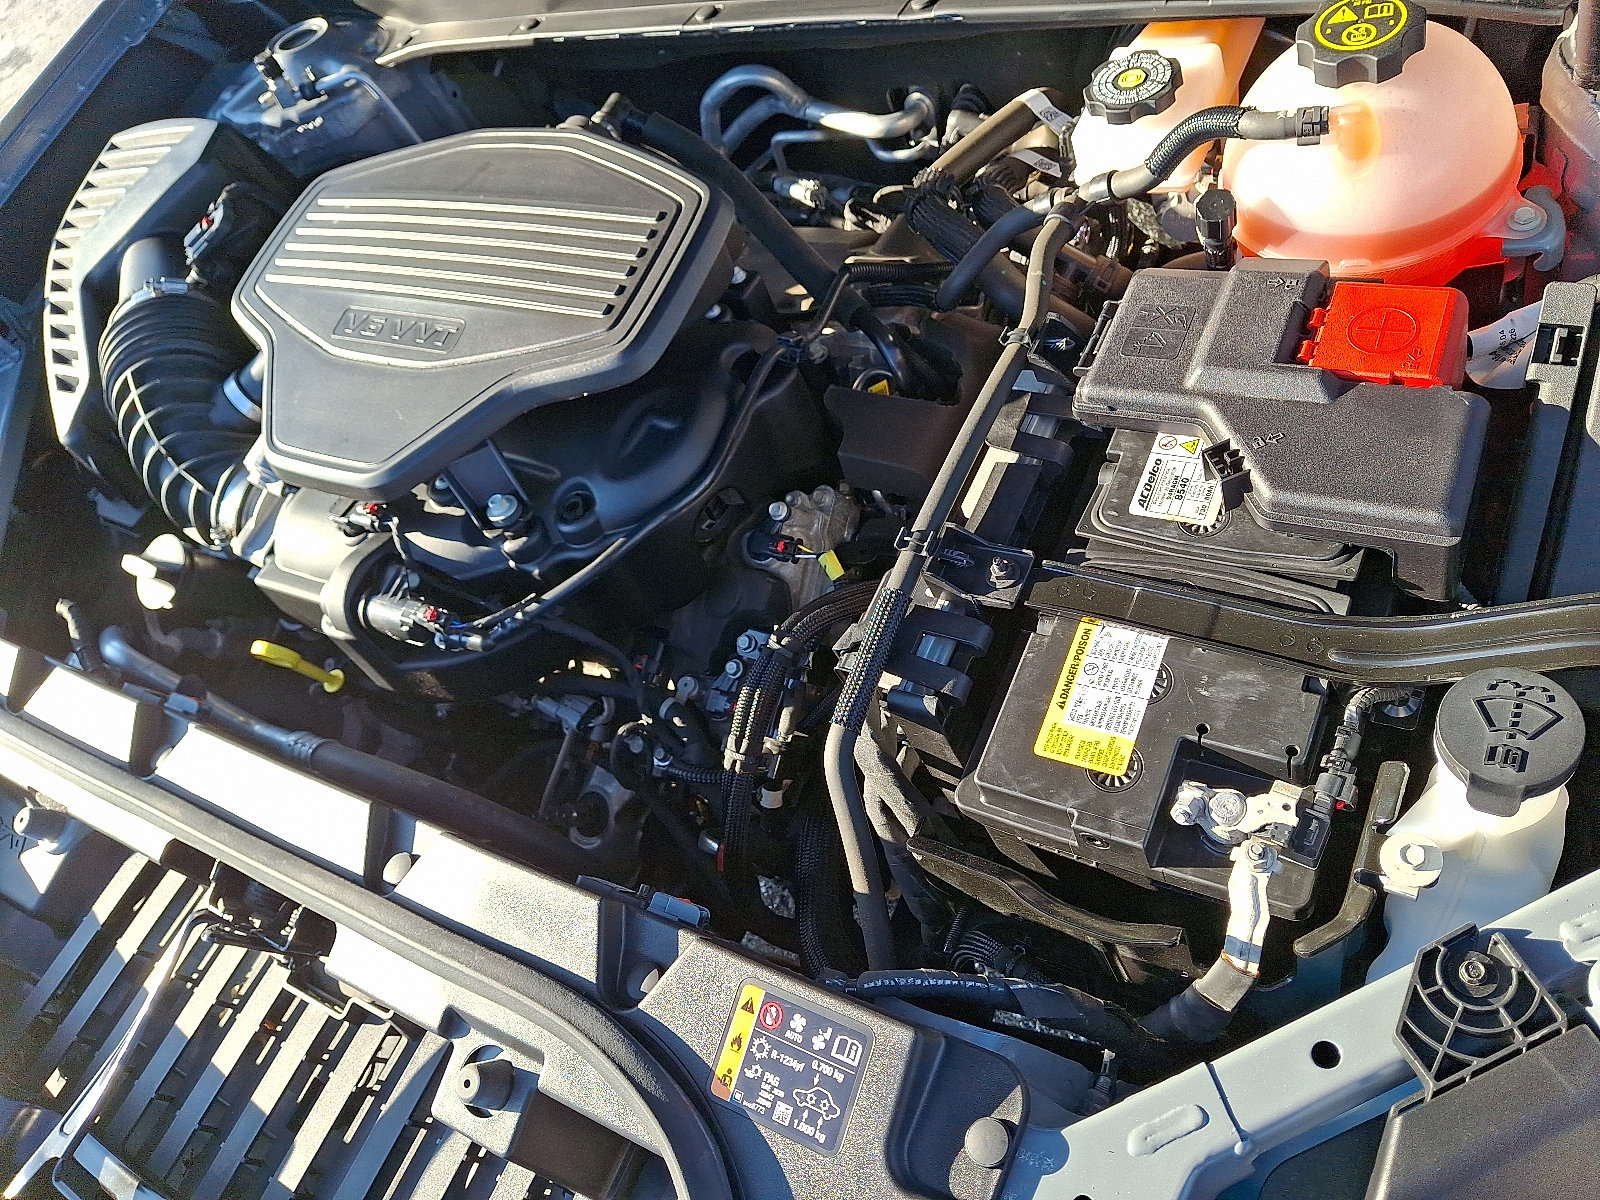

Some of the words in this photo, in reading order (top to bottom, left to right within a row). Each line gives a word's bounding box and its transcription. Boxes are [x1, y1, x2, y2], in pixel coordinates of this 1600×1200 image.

[391, 318, 459, 347] VVT
[1137, 458, 1162, 509] ACDelco
[1175, 477, 1189, 501] 8540
[1060, 627, 1093, 702] DANGER/POISON
[784, 1029, 803, 1044] AUTO
[770, 1049, 806, 1073] R-1234yf
[763, 1072, 781, 1087] PAG
[832, 1068, 845, 1084] kg
[814, 1128, 827, 1144] kg
